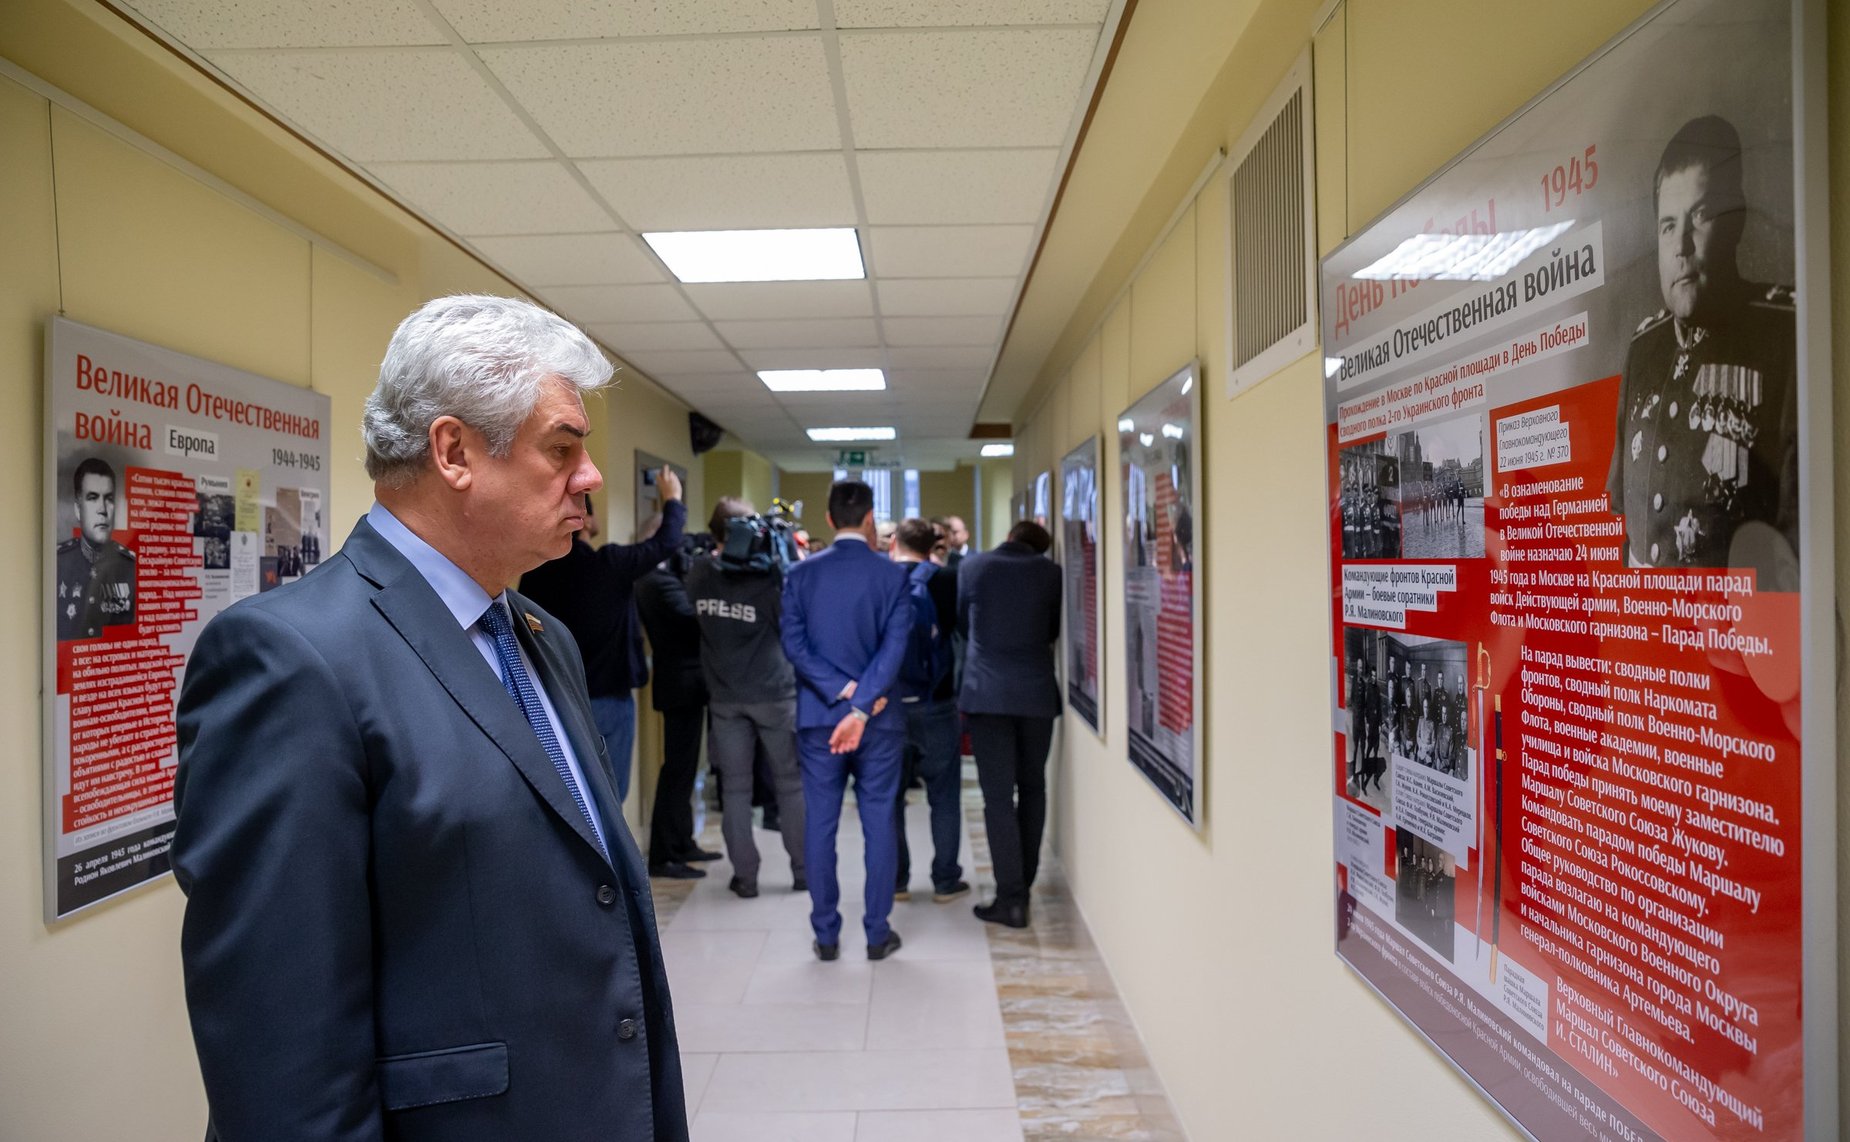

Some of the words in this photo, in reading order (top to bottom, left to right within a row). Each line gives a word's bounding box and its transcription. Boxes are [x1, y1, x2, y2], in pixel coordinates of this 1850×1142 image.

[1541, 144, 1599, 212] 1945
[1336, 279, 1384, 341] День
[1340, 340, 1389, 381] Великая
[1393, 280, 1517, 358] Отечественная
[1524, 244, 1596, 302] война
[76, 354, 178, 410] Великая
[186, 383, 320, 440] Отечественная
[1340, 396, 1380, 420] Прохождение
[1380, 395, 1385, 405] в
[1386, 385, 1412, 402] Москве
[1413, 381, 1422, 394] по
[1424, 365, 1458, 394] Красной
[1460, 353, 1500, 378] площади
[1502, 350, 1509, 364] в
[1511, 341, 1537, 365] День
[1540, 322, 1585, 351] Победы
[75, 409, 152, 450] война
[1340, 418, 1367, 438] сводного
[1367, 414, 1386, 428] полка
[1402, 394, 1449, 421] Украинского
[1451, 383, 1483, 409] фронта
[1498, 420, 1520, 435] Приказ
[1521, 409, 1559, 429] Верховного
[170, 429, 215, 456] Европа
[272, 448, 320, 472] 1944-1945
[1499, 428, 1567, 450] Главнокомандующего
[1499, 456, 1506, 468] 22
[1507, 455, 1523, 466] июня
[1524, 450, 1538, 463] 1945
[1556, 444, 1569, 458] 370
[1498, 483, 1509, 498] «В
[1512, 476, 1583, 496] ознаменование
[1499, 502, 1531, 520] победы
[1533, 503, 1550, 518] над
[1552, 493, 1607, 520] Германией
[1500, 530, 1505, 540] в
[1506, 522, 1543, 539] Великой
[1545, 517, 1622, 538] Отечественной
[1500, 546, 1525, 561] войне
[1527, 548, 1573, 560] назначаю
[1575, 544, 1587, 560] 24
[1590, 546, 1619, 560] июня
[1344, 569, 1388, 585] Командующие
[1389, 567, 1419, 586] фронтов
[1421, 569, 1453, 587] Красной
[1344, 586, 1364, 602] Армии
[1372, 586, 1396, 602] боевые
[1397, 592, 1434, 607] соратники
[1490, 566, 1508, 584] 1945
[1509, 572, 1528, 587] года
[1530, 573, 1536, 584] в
[1538, 570, 1574, 586] Москве
[1576, 574, 1589, 586] на
[1592, 570, 1640, 592] Красной
[1643, 574, 1702, 594] площади
[1706, 575, 1752, 597] парад
[696, 599, 756, 623] PRESS
[1357, 605, 1403, 622] Малиновского
[1490, 589, 1513, 605] войск
[1515, 591, 1579, 613] Действующей
[1581, 597, 1620, 616] армии,
[1623, 596, 1742, 624] Военно-Морского
[1490, 610, 1516, 631] Флота
[1517, 615, 1524, 629] и
[1525, 613, 1587, 634] Московского
[1590, 622, 1648, 641] гарнизона
[1662, 624, 1704, 650] Парад
[1708, 627, 1773, 656] Победы.
[1520, 644, 1533, 661] На
[1534, 650, 1563, 669] парад
[1565, 654, 1611, 674] вывести:
[1614, 662, 1666, 682] сводные
[1669, 669, 1710, 690] полки
[1521, 665, 1562, 691] фронтов,
[1565, 677, 1610, 698] сводный
[1613, 686, 1641, 704] полк
[1644, 688, 1717, 720] Наркомата
[1521, 686, 1565, 715] Обороны,
[1568, 701, 1614, 723] сводный
[1617, 711, 1644, 730] полк
[1648, 714, 1775, 762] Военно-Морского
[1521, 709, 1551, 734] Флота,
[1554, 720, 1597, 743] военные
[1599, 732, 1660, 764] академии,
[1664, 748, 1723, 778] военные
[1521, 733, 1561, 757] училища
[1563, 745, 1570, 758] и
[1572, 747, 1609, 770] войска
[1612, 756, 1692, 796] Московского
[1695, 784, 1779, 824] гарнизона.
[1521, 752, 1550, 777] Парад
[1551, 763, 1589, 789] победы
[1591, 777, 1638, 804] принять
[1640, 793, 1682, 826] моему
[1684, 808, 1784, 856] заместителю
[1521, 773, 1565, 807] Маршалу
[1566, 789, 1626, 825] Советского
[1628, 812, 1668, 842] Союза
[1671, 826, 1728, 869] Жукову.
[74, 871, 98, 886] Родион
[100, 860, 132, 876] Яковлевич
[86, 855, 108, 869] апреля
[111, 848, 125, 860] 1945
[128, 843, 141, 854] года
[1521, 794, 1583, 832] Командовать
[1586, 823, 1634, 854] парадом
[1637, 843, 1685, 875] победы
[1689, 860, 1760, 913] Маршалу
[1521, 816, 1572, 850] Советского
[1574, 838, 1608, 867] Союза
[1611, 853, 1708, 916] Рокоссовскому.
[1521, 837, 1551, 863] Общее
[1553, 854, 1618, 895] руководство
[1620, 886, 1635, 904] по
[1637, 895, 1723, 949] организации
[1521, 860, 1553, 887] парада
[1555, 878, 1602, 912] возлагаю
[1605, 903, 1618, 921] на
[1621, 911, 1720, 974] командующего
[1520, 902, 1526, 916] и
[1528, 907, 1583, 949] начальника
[1586, 940, 1644, 986] гарнизона
[1647, 976, 1692, 1015] города
[1696, 1000, 1756, 1054] Москвы
[1521, 882, 1564, 915] войсками
[1567, 903, 1637, 956] Московского
[1641, 943, 1701, 992] Военного
[1704, 979, 1758, 1026] Округа
[1520, 924, 1620, 996] генерал-полковника
[1622, 984, 1694, 1044] Артемьева.
[1468, 998, 1511, 1043] Малиновский
[1514, 1038, 1559, 1083] командовал
[1562, 1077, 1572, 1093] на
[1574, 1088, 1606, 1121] параде
[1555, 1020, 1566, 1041] И.
[1568, 1030, 1618, 1077] СТАЛИН»
[1556, 976, 1613, 1028] Верховный
[1617, 1015, 1762, 1131] Главнокомандующий
[1556, 998, 1598, 1041] Маршал
[1601, 1030, 1667, 1090] Советского
[1670, 1079, 1715, 1126] Союза
[1524, 1067, 1577, 1120] освободившей
[1580, 1114, 1597, 1137] весь
